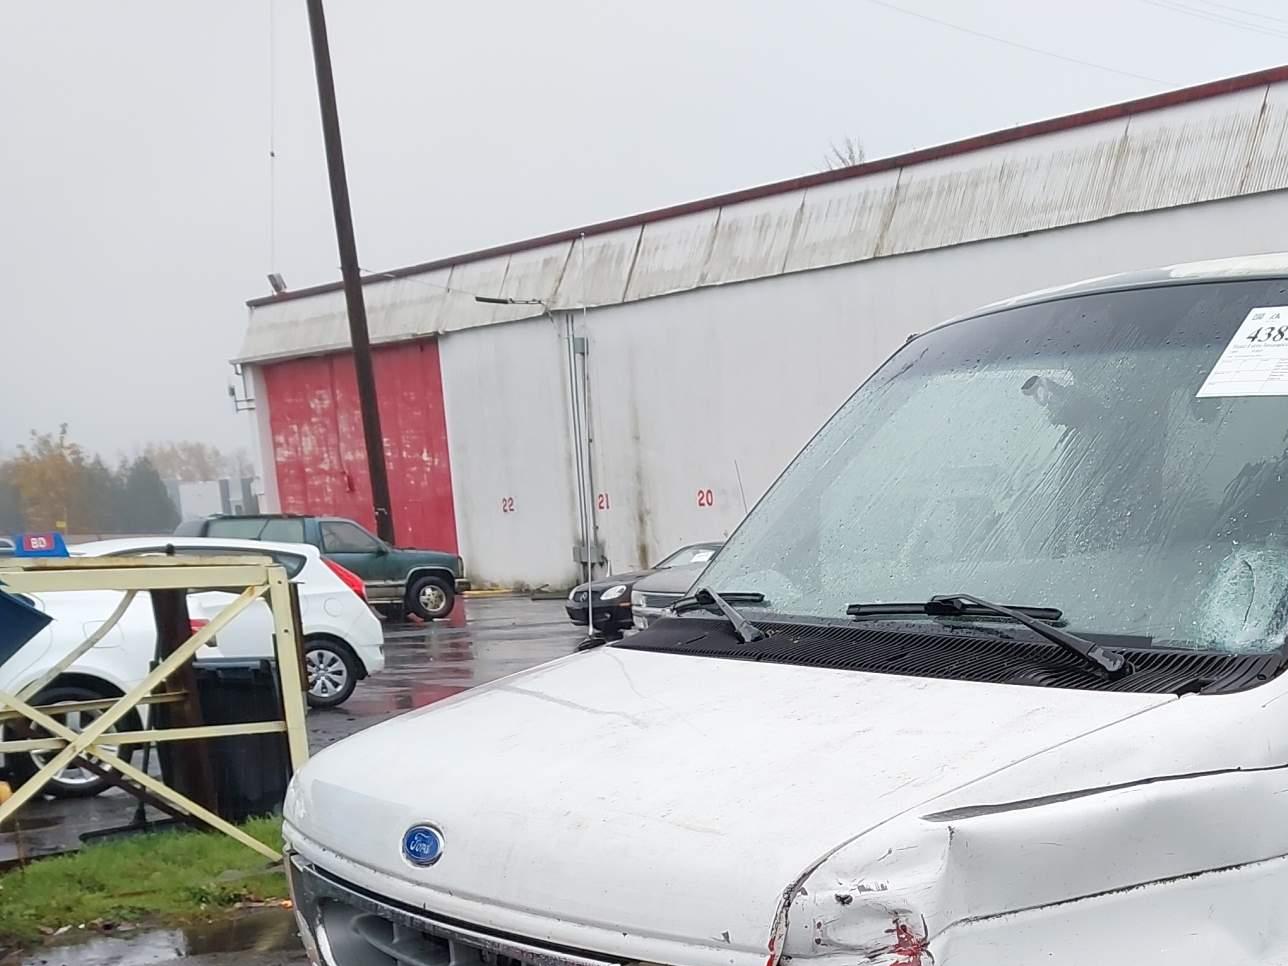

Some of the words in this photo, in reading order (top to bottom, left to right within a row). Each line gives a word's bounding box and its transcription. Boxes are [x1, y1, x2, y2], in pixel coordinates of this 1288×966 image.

[502, 497, 514, 512] 22
[598, 493, 610, 510] 21
[697, 489, 714, 507] 20
